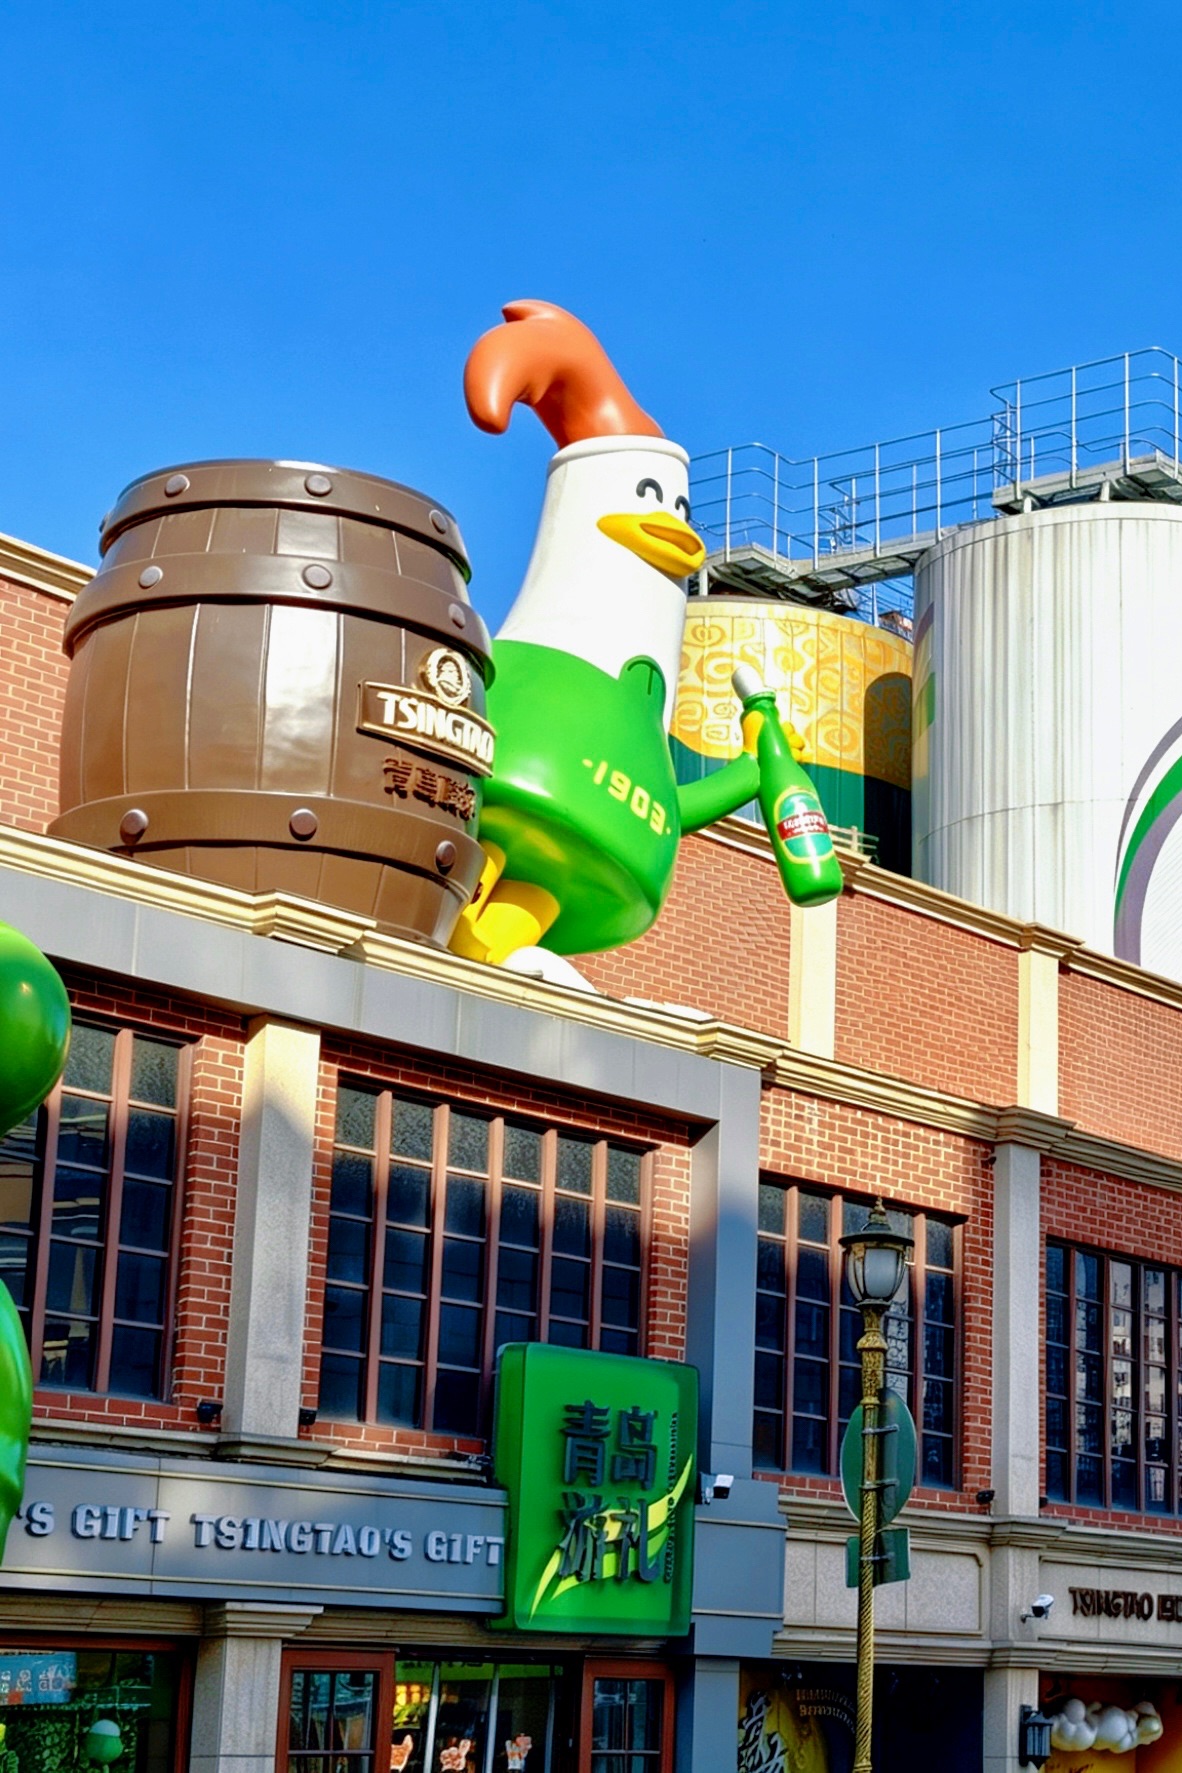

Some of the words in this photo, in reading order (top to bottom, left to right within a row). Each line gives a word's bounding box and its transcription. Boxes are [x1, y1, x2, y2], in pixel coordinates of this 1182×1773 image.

[376, 691, 495, 763] TSINGTAO
[592, 760, 667, 836] 1903
[560, 1400, 659, 1490] 青岛
[71, 1503, 171, 1544] GIFT
[190, 1513, 412, 1561] TSINGTAO'S
[424, 1530, 505, 1566] GIFT
